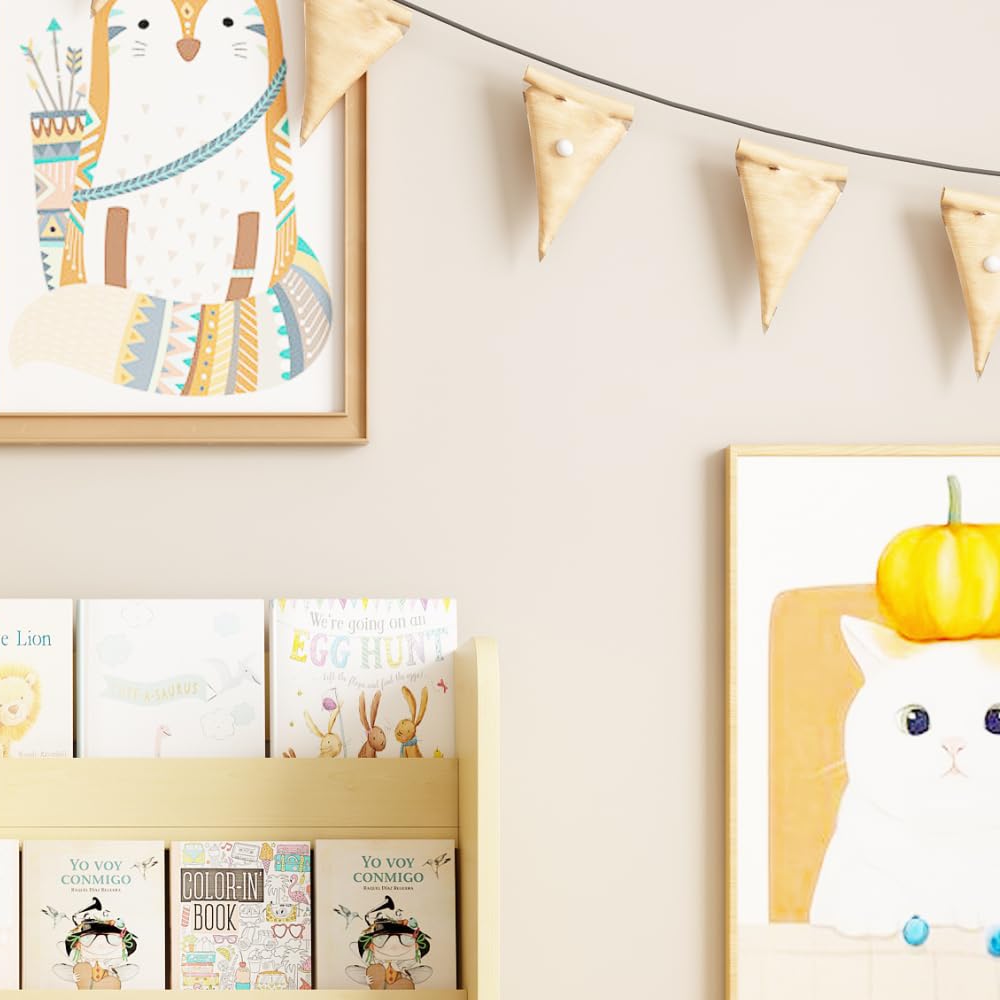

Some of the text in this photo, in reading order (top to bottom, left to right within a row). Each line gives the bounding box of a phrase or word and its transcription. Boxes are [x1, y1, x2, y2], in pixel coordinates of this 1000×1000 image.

[310, 611, 426, 634] We're going on an
[17, 630, 52, 646] Lion
[289, 627, 448, 669] EGG HUNT
[61, 874, 132, 885] CONMIGO
[353, 872, 424, 883] CONMIGO
[194, 903, 237, 931] BOOK
